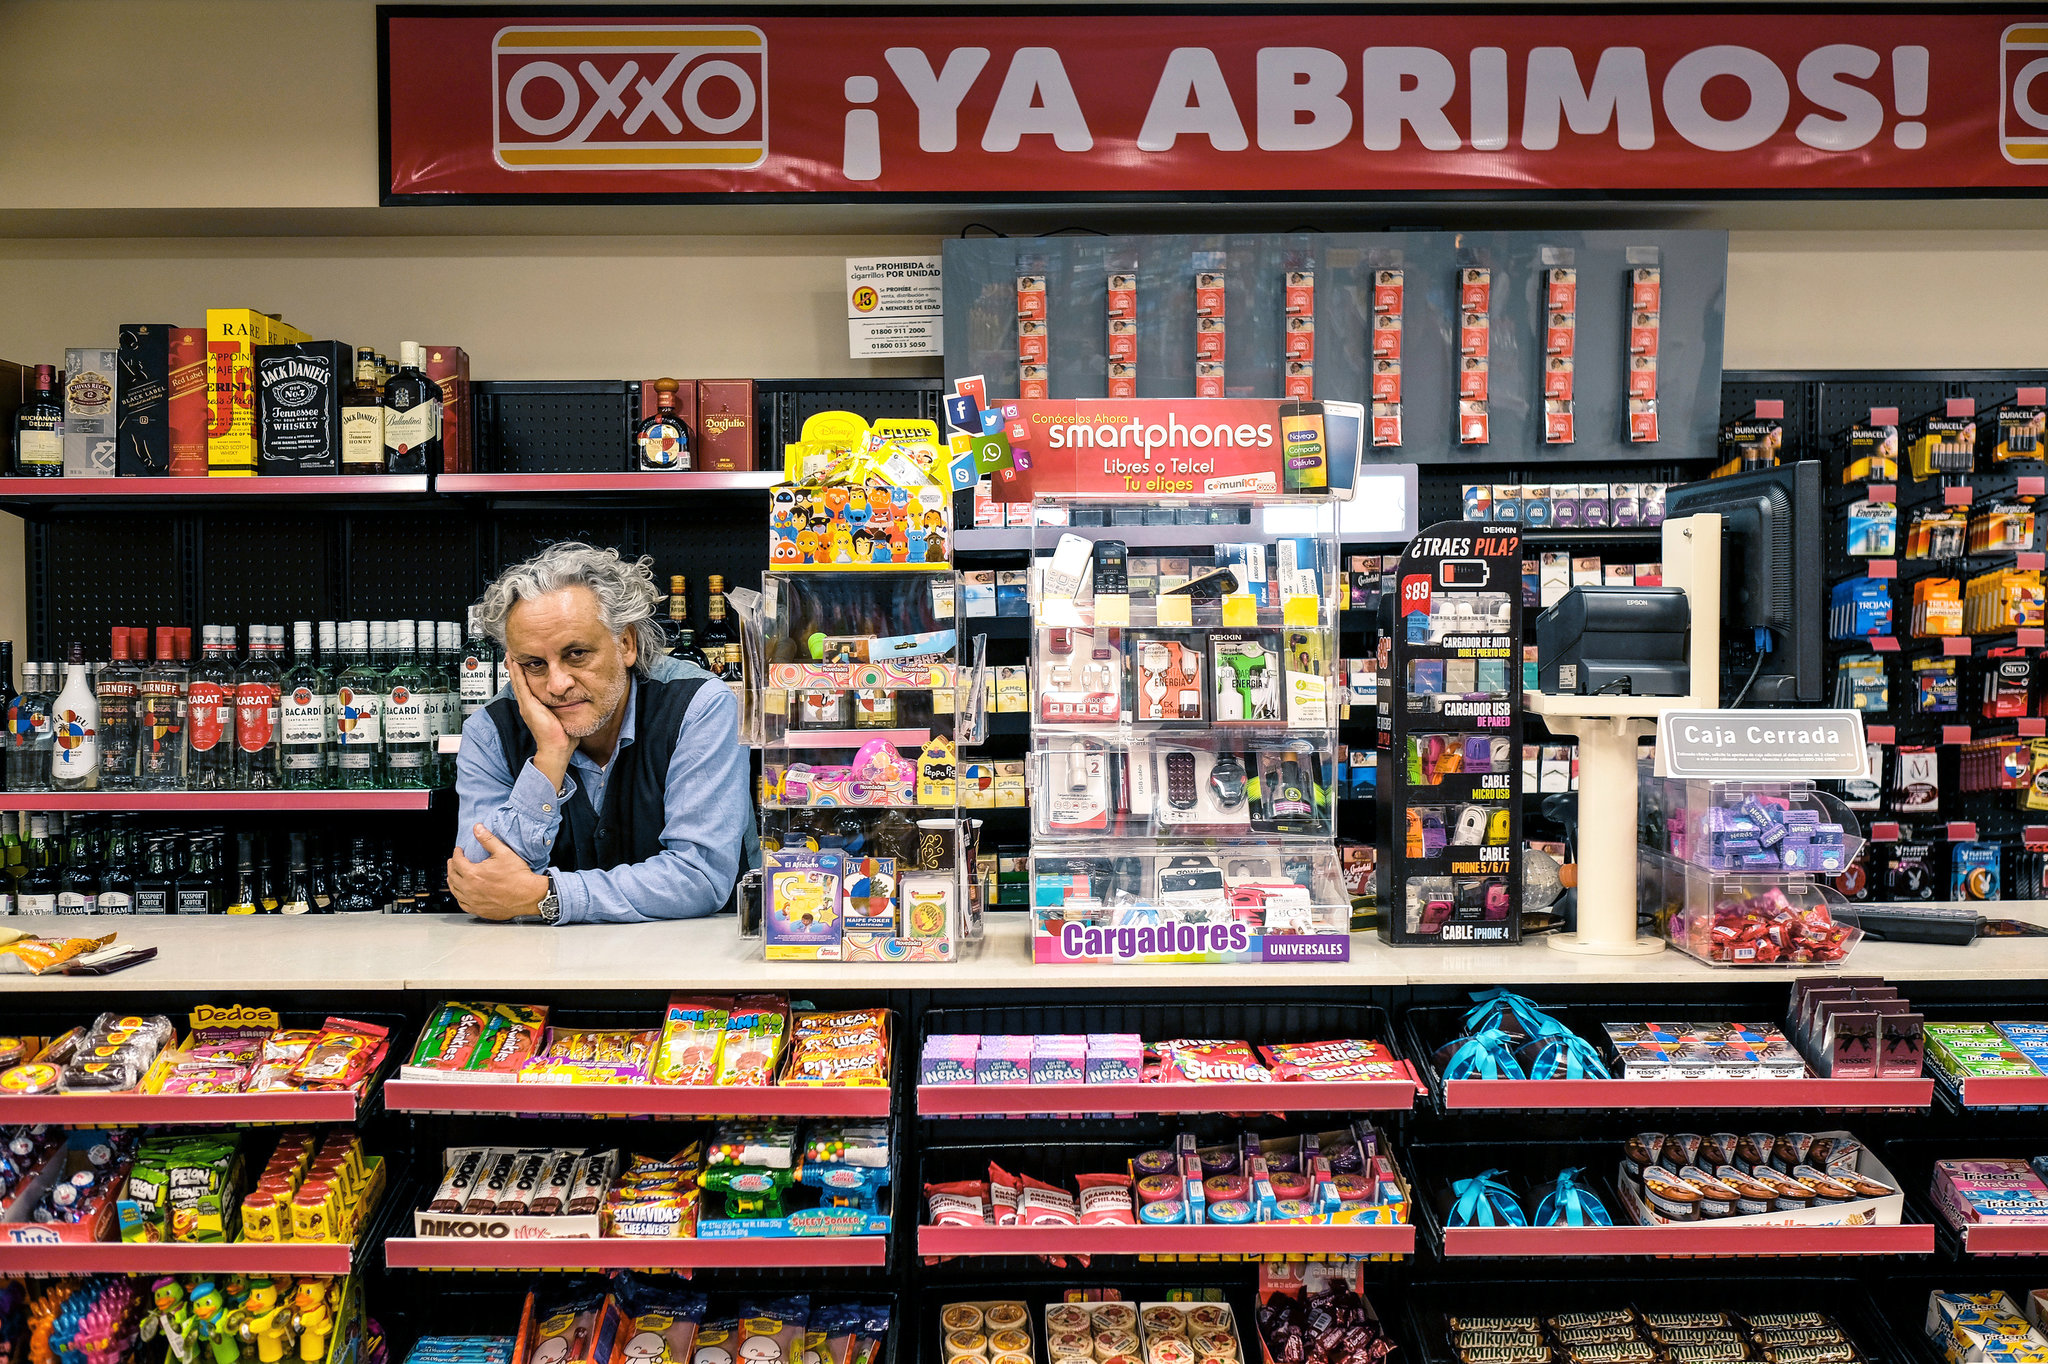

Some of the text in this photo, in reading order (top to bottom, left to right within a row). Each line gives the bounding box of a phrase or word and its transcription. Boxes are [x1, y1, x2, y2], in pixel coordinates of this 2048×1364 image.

[506, 60, 756, 135] OXXO
[843, 47, 1094, 180] ¡YA
[1137, 44, 1929, 151] ABRIMOS!
[851, 272, 884, 280] cigarrillos
[260, 360, 331, 388] JACK DANIEL'S
[70, 383, 110, 393] CHIVAS REGAL
[122, 386, 166, 404] BLACK LABEL
[272, 407, 318, 418] Tennessee
[2000, 412, 2034, 420] DURACELL
[1032, 413, 1128, 424] Conócelos Ahora
[273, 422, 318, 430] WHISKEY
[1049, 413, 1273, 459] smartphones
[1290, 431, 1315, 442] Navega
[1289, 444, 1320, 454] Comparte
[1104, 458, 1214, 474] Libres o Telcel
[1293, 458, 1316, 468] Disfruta
[1124, 476, 1193, 494] Tu eliges
[1856, 510, 1892, 519] Energizer
[1994, 504, 2032, 514] Energizer
[1412, 537, 1518, 558] ¿TRAES PILA?
[1405, 581, 1429, 600] $89
[1858, 602, 1890, 610] TROJAN
[1443, 637, 1510, 648] CARGADOR DE AUTO
[1458, 649, 1510, 657] DOBLE PUERTO USB
[188, 694, 220, 704] KARAT
[236, 696, 270, 706] KARAT
[286, 704, 321, 716] BACARDÍ
[386, 704, 420, 715] BACARDÍ
[1445, 703, 1510, 716] CARGADOR USB
[53, 714, 88, 727] MABU
[1478, 717, 1510, 726] DE PARED
[1685, 726, 1840, 746] Caja Cerrada
[925, 766, 944, 777] Peppa
[1482, 775, 1510, 788] CABLE
[1472, 789, 1510, 800] MICRO USB
[1480, 847, 1510, 862] CABLE
[794, 861, 818, 870] Alfabeto
[821, 858, 837, 866] Disney
[1452, 862, 1480, 873] IPHONE
[1443, 926, 1510, 940] CABLE IPHONE 4
[1063, 923, 1247, 958] Cargadores
[1270, 944, 1343, 956] UNIVERSALES
[196, 1008, 272, 1023] Dedos
[1294, 1048, 1374, 1066] Skittles
[1186, 1059, 1272, 1082] Skittles
[1310, 1063, 1393, 1080] Skittles
[171, 1168, 210, 1187] PELON
[1960, 1172, 2022, 1182] Trident
[170, 1186, 210, 1200] PELONETA
[1985, 1200, 2048, 1208] Trident
[614, 1208, 682, 1223] SALVAVIDAS
[792, 1216, 860, 1226] SWEET SOAKER
[624, 1224, 670, 1235] LIFESAVERS
[10, 1230, 60, 1244] Tutsi
[1938, 1320, 1968, 1356] Trident
